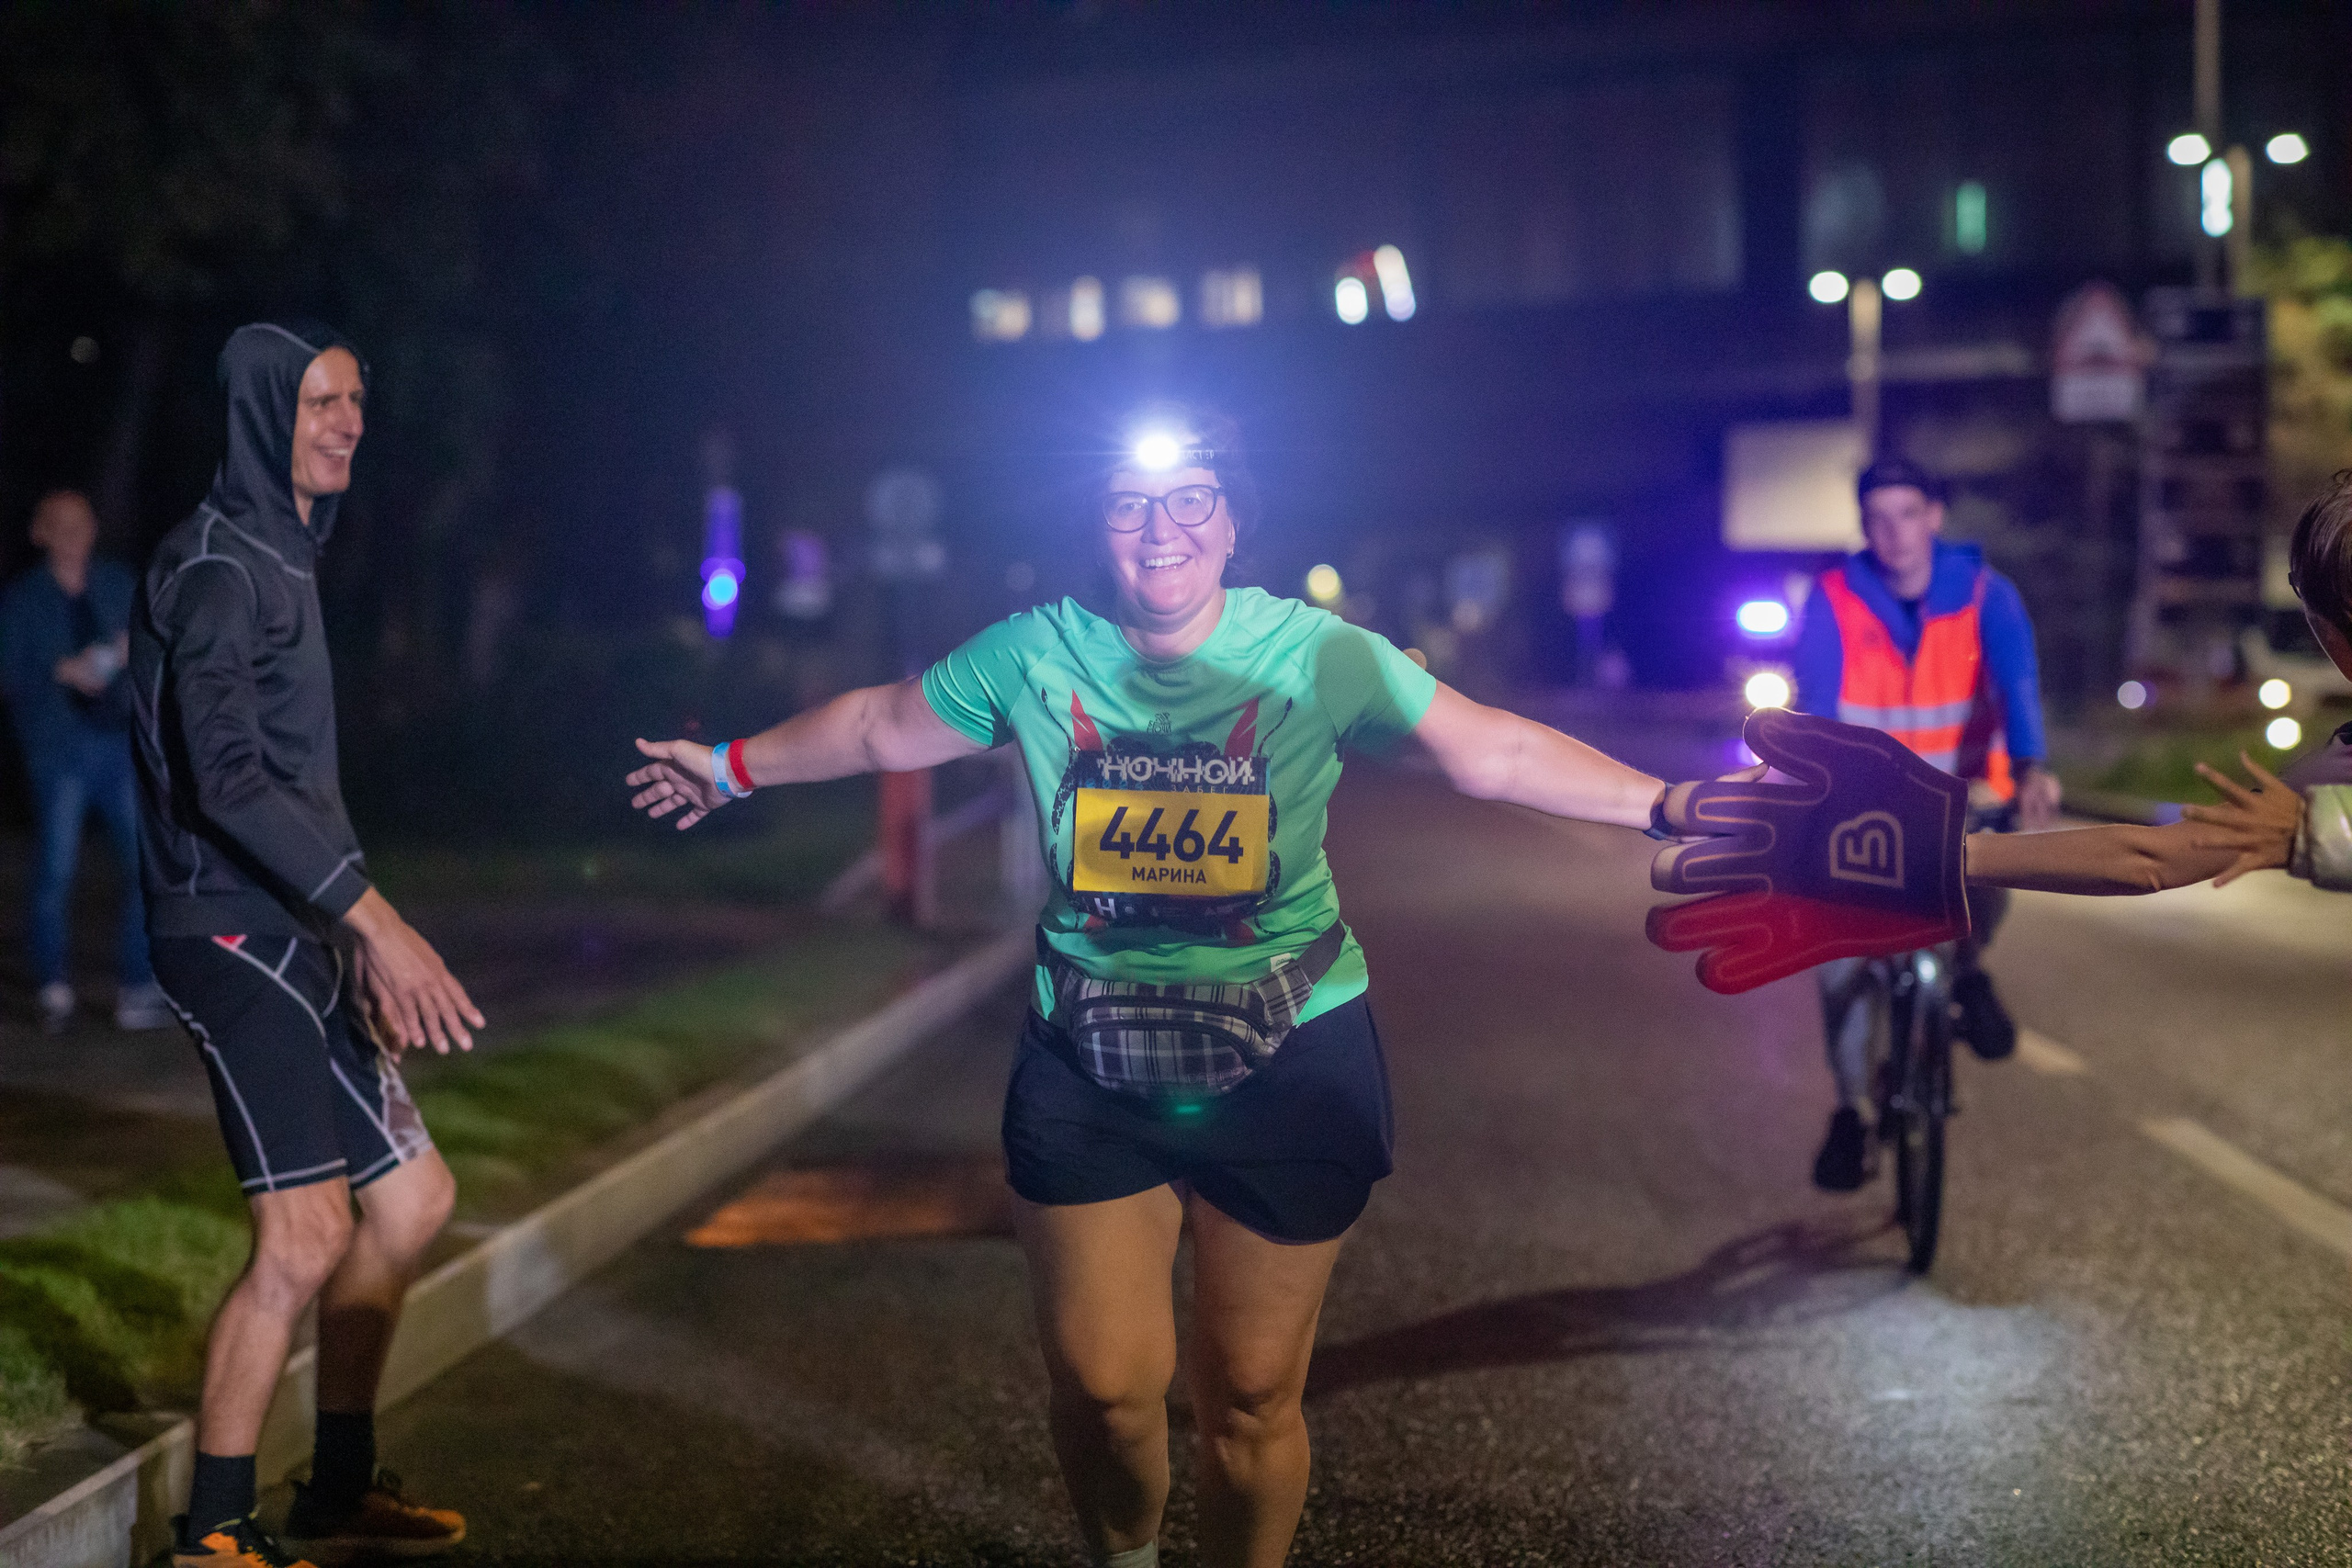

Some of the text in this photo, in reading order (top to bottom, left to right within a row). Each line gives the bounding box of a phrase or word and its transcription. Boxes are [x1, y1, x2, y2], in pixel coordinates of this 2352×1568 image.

[1098, 753, 1255, 785] НОЧНОЙ
[1170, 784, 1228, 795] ЗАБЕГ
[1099, 806, 1244, 864] 4464
[1131, 866, 1207, 885] МАРИНА
